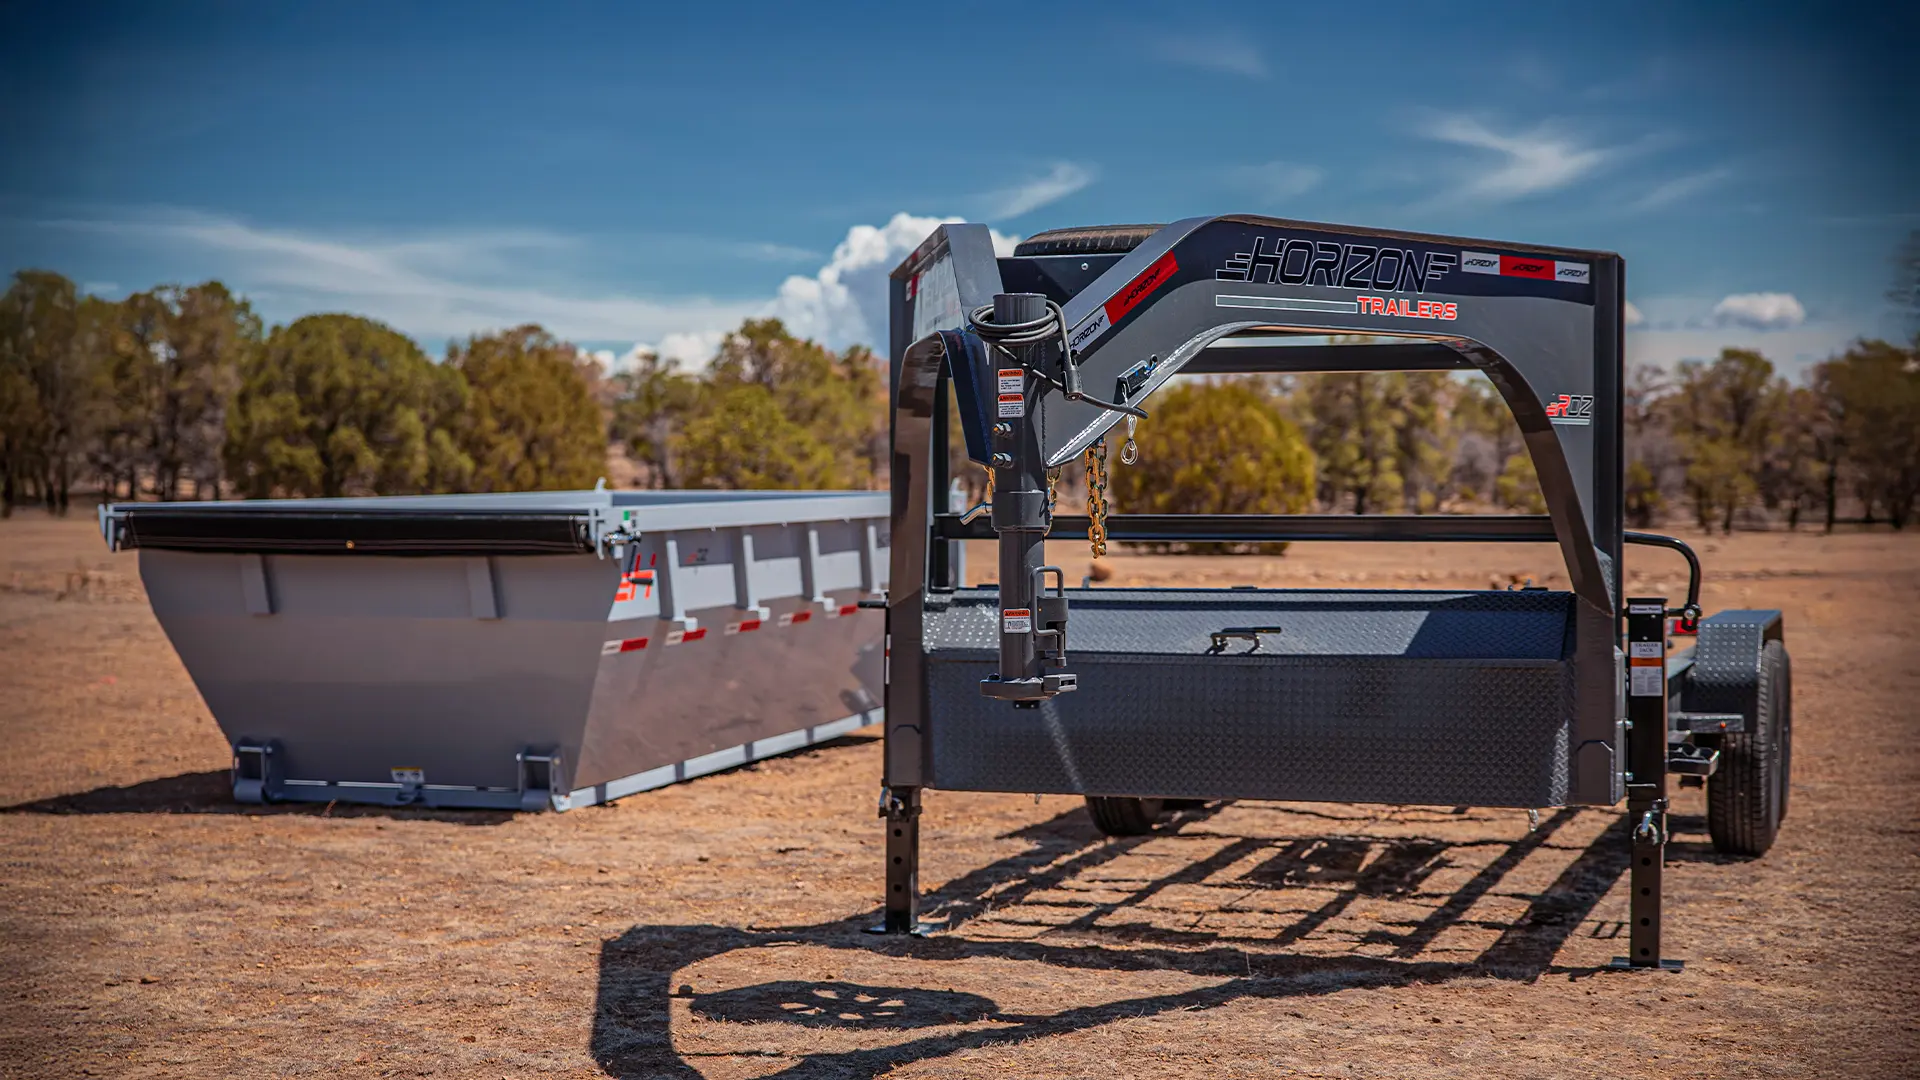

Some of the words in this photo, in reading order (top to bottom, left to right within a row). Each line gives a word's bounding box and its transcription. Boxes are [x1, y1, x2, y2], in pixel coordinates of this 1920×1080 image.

[1233, 236, 1444, 294] HORIZON
[1124, 268, 1160, 306] HORIZON
[1356, 295, 1458, 321] TRAILERS
